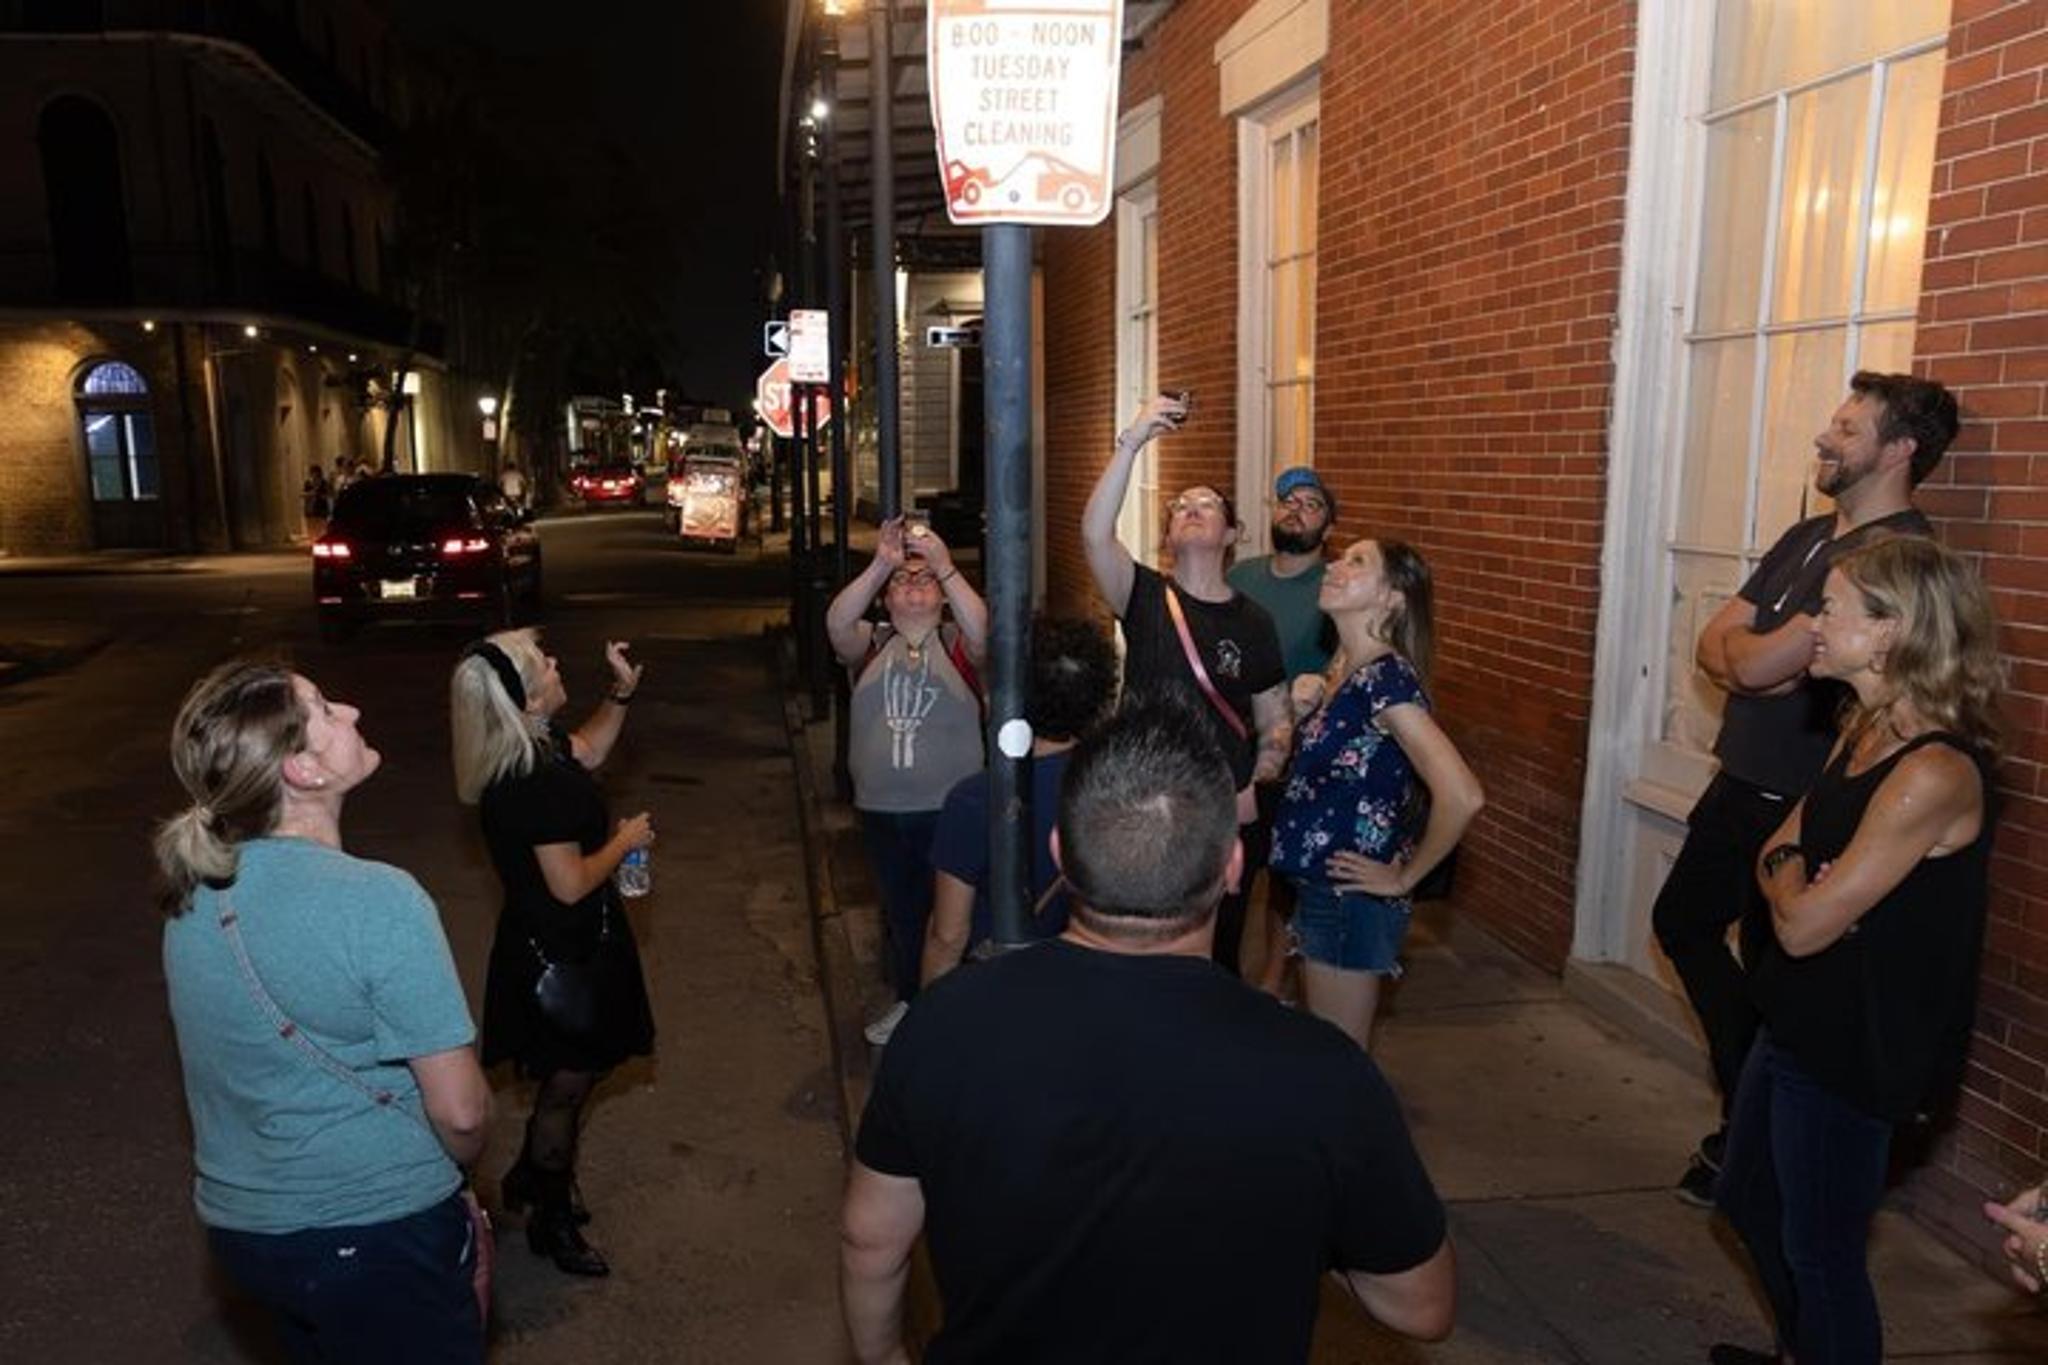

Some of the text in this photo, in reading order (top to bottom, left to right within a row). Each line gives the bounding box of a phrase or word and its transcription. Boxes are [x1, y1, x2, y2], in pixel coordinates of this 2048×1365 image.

[1032, 22, 1095, 46] NOON
[972, 55, 1070, 80] TUESDAY
[979, 87, 1057, 112] STREET
[964, 121, 1072, 146] CLEANING
